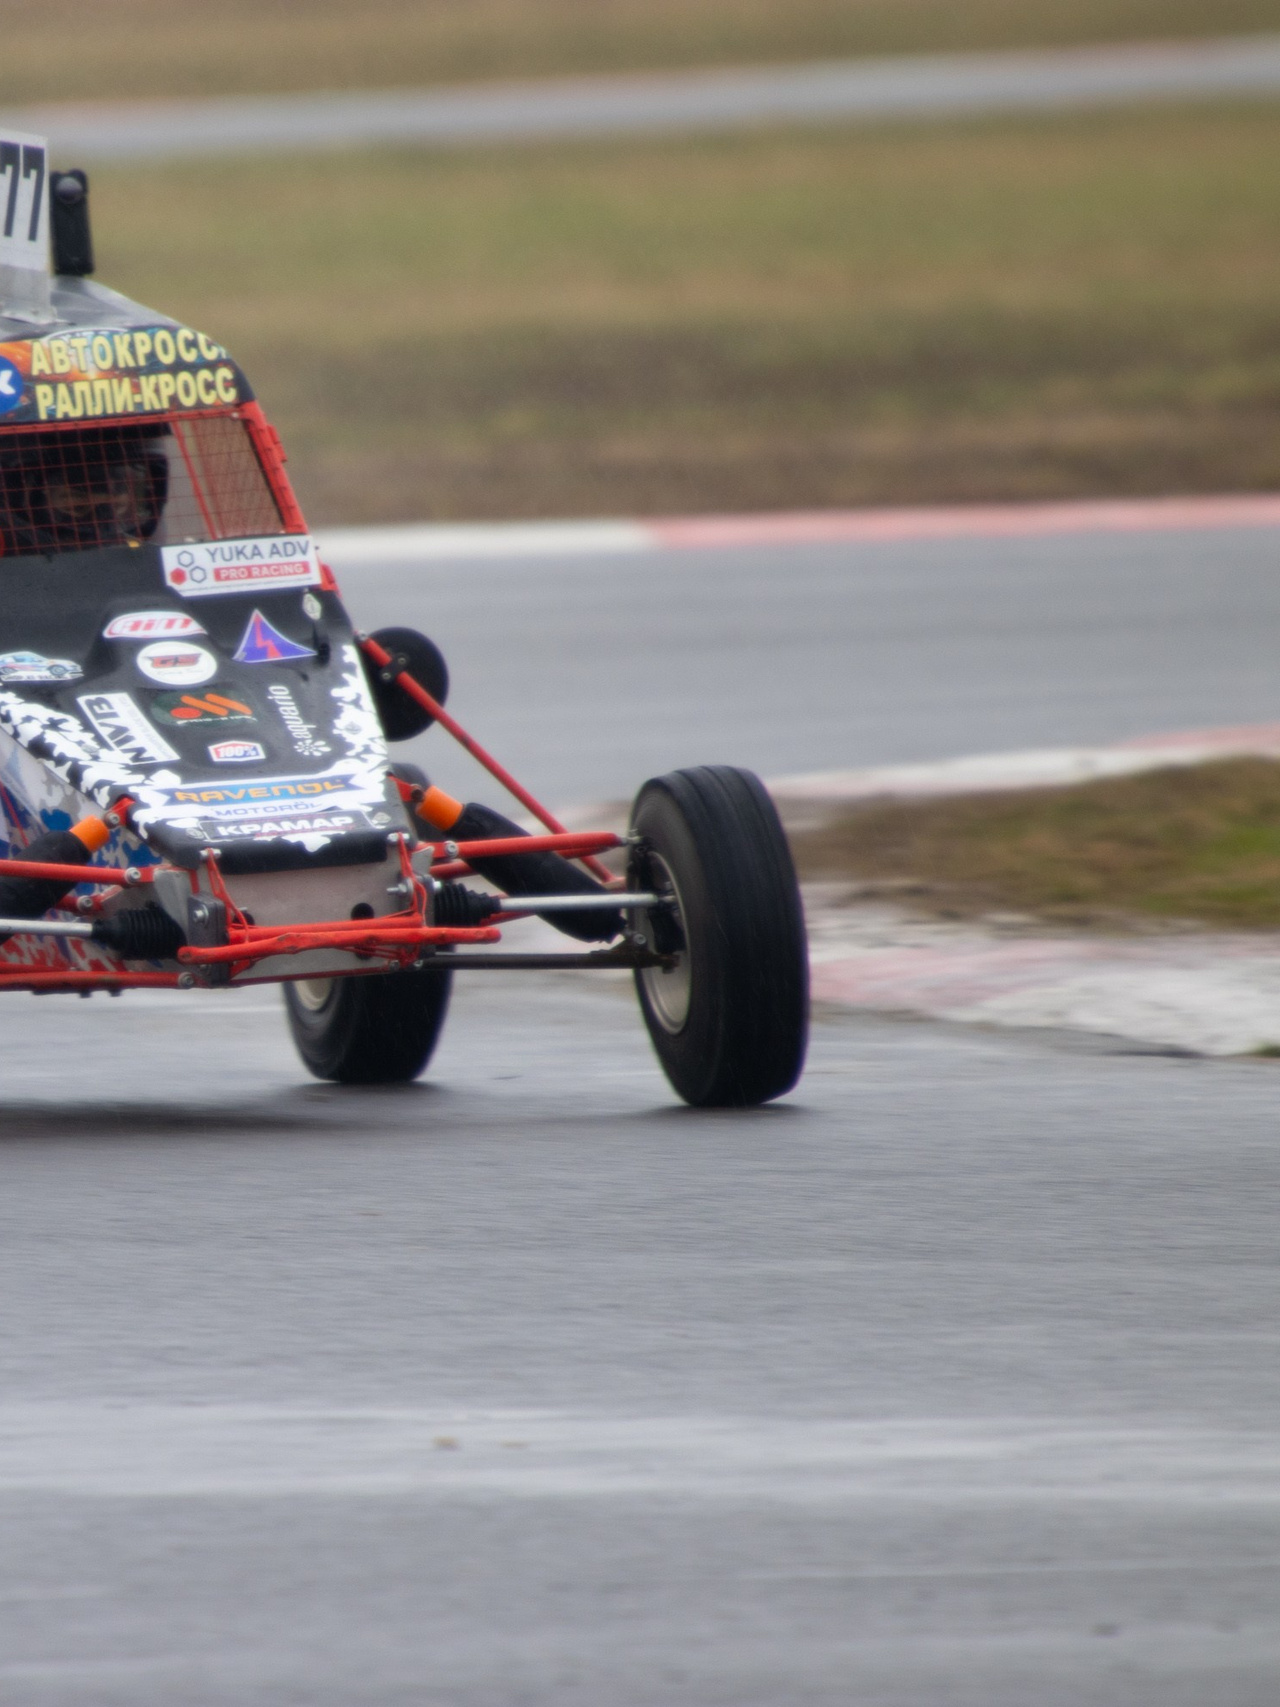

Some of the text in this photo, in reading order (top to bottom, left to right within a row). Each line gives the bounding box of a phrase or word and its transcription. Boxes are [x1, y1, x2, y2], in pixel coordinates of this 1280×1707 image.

[31, 328, 219, 375] АВТОКРОСС
[35, 367, 238, 420] РАЛЛИ-КРОСС
[205, 540, 310, 563] YUKA ADV
[221, 563, 305, 580] PRO RACING
[267, 685, 317, 739] aquario
[218, 745, 259, 758] 100%
[175, 780, 346, 803] RAVENOL
